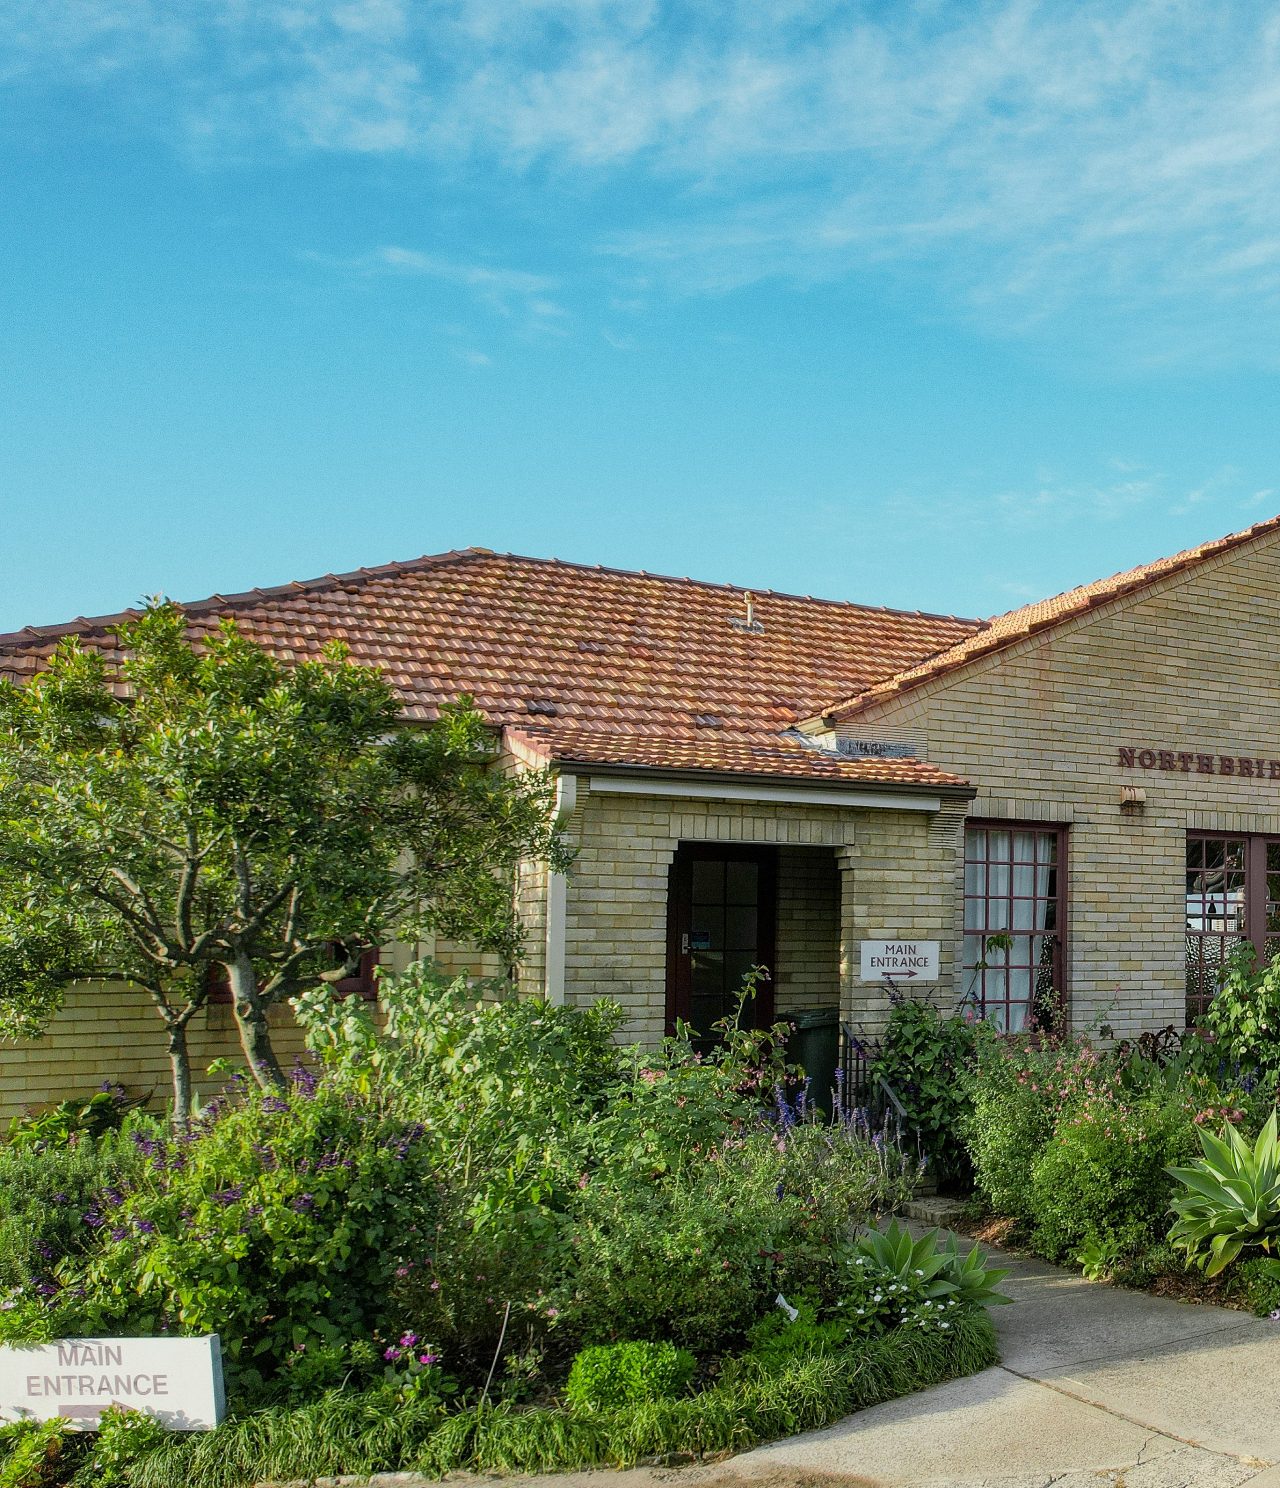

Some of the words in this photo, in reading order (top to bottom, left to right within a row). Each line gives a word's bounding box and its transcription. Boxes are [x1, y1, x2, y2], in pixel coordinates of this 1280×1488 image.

[885, 944, 916, 955] MAIN
[870, 956, 929, 968] ENTRANCE
[57, 1345, 123, 1367] MAIN
[26, 1374, 169, 1397] ENTRANCE
